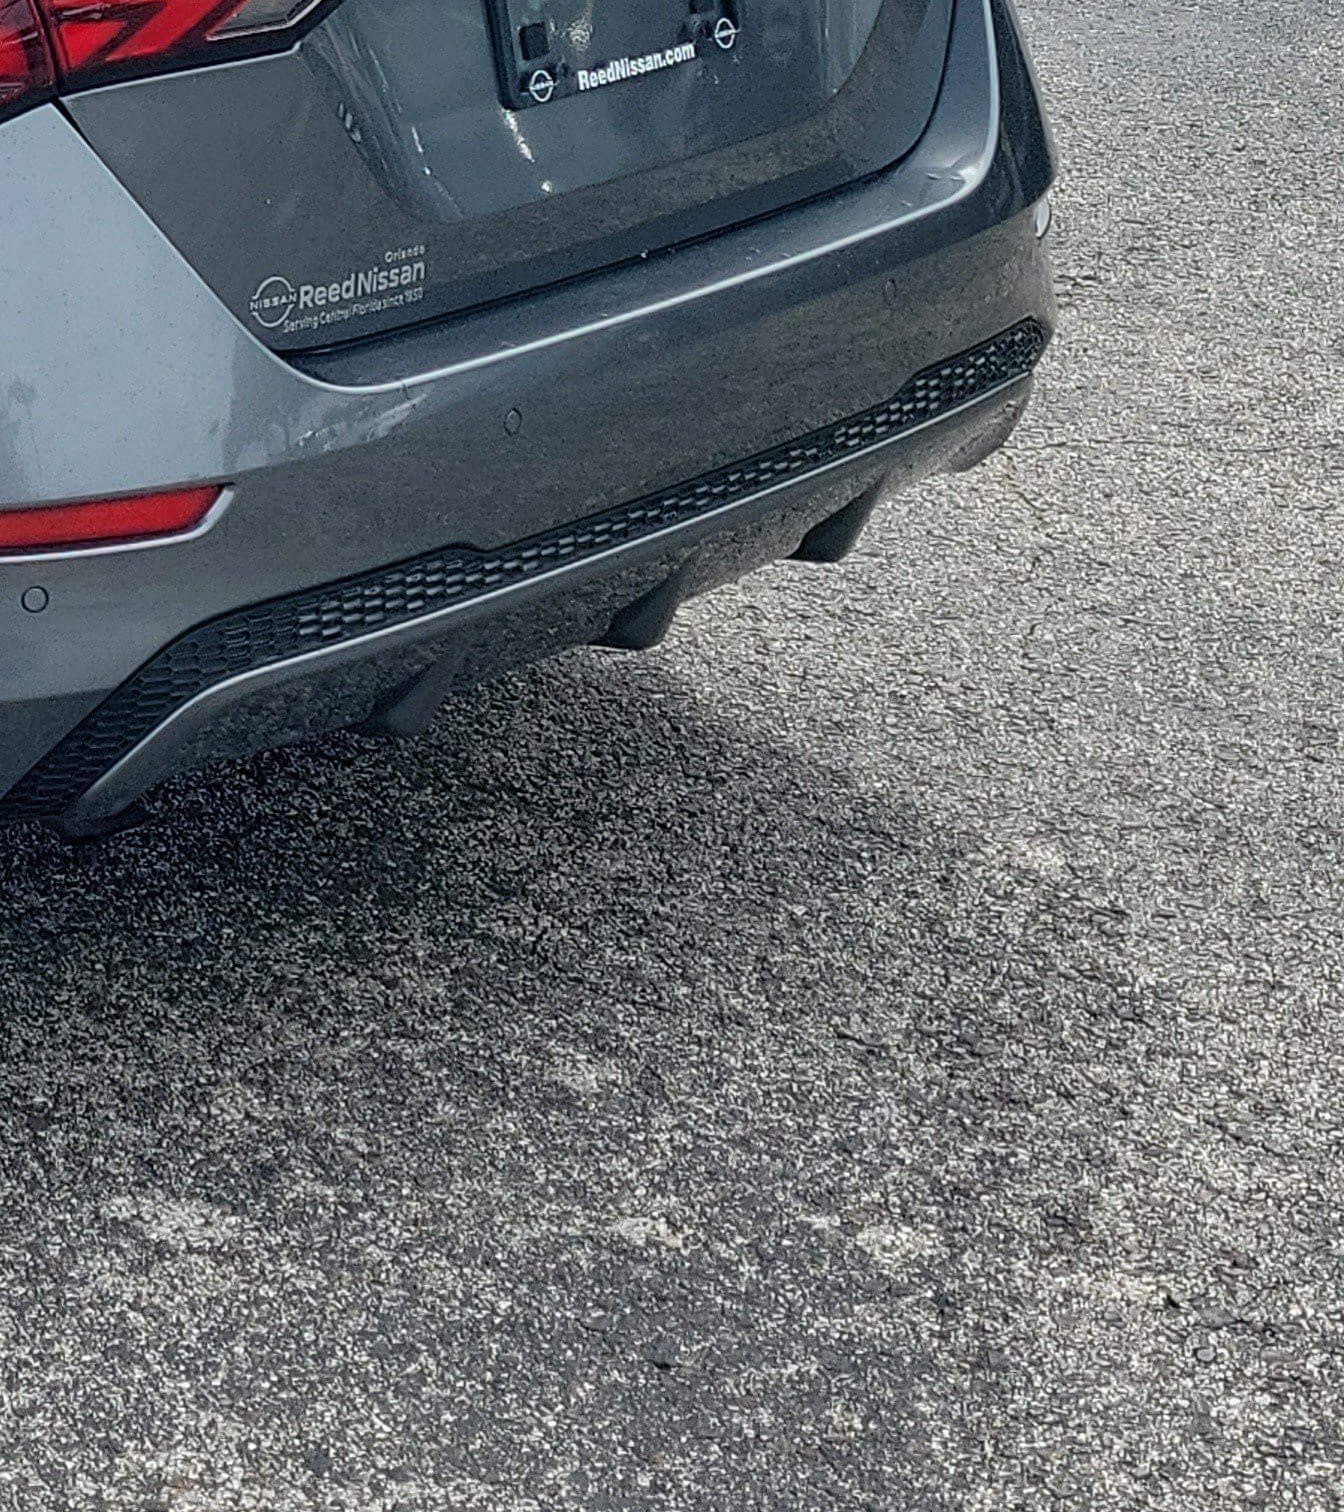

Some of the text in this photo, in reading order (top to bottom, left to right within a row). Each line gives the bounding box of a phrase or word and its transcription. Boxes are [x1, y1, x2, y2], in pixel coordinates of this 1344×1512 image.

[577, 42, 696, 91] ReedNissan.com
[385, 245, 425, 263] Orlando
[249, 292, 297, 310] NISSAN
[283, 315, 318, 333] Serving
